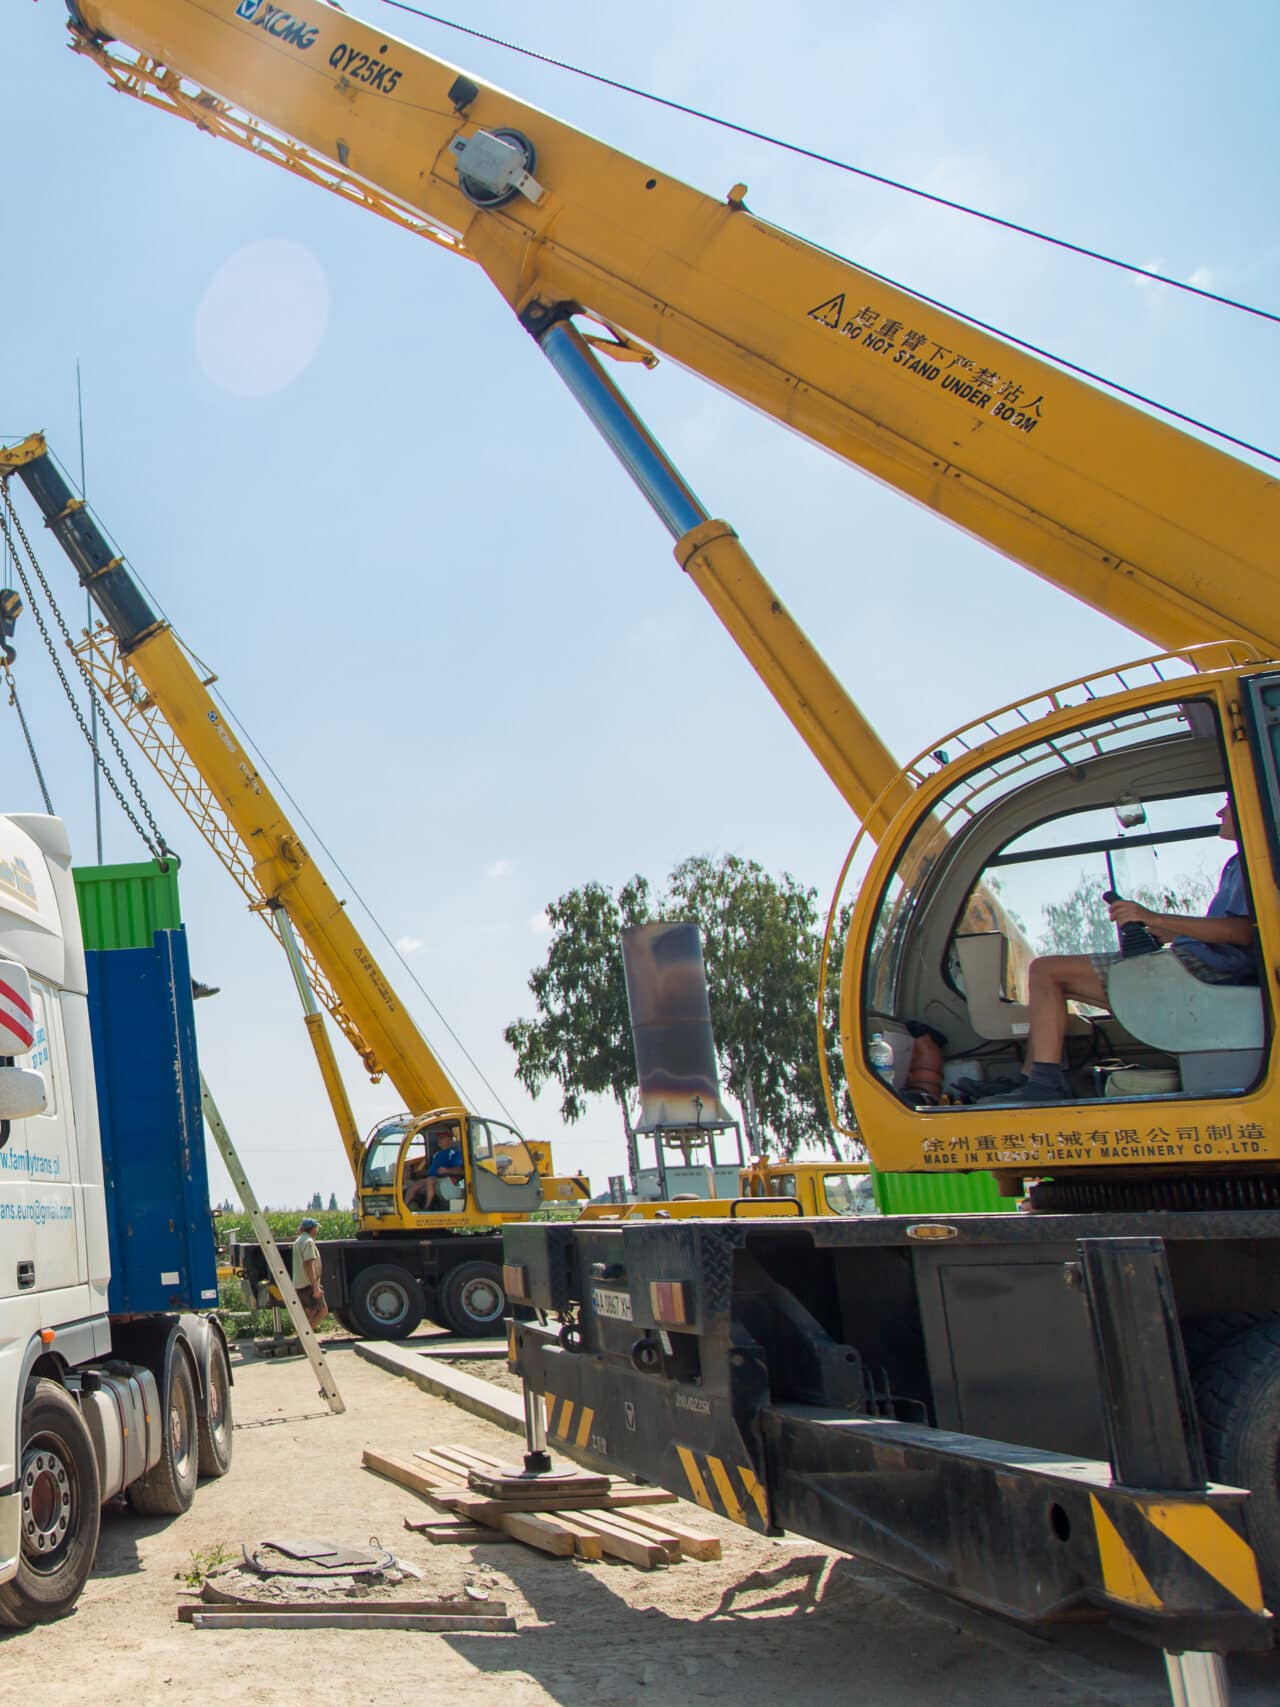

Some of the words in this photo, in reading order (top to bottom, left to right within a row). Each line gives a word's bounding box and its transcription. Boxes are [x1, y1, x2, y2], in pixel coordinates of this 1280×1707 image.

[255, 5, 320, 50] XCMG
[328, 43, 403, 94] QY25K5
[840, 321, 862, 340] DO
[862, 333, 894, 356] NOT
[893, 349, 941, 381] STAND
[940, 373, 992, 409] UNDER
[991, 401, 1038, 433] BOOM
[923, 1153, 959, 1165] MADE
[965, 1152, 980, 1164] IN
[1048, 1148, 1092, 1161] HEAVY
[1100, 1145, 1184, 1158] MACHINERY
